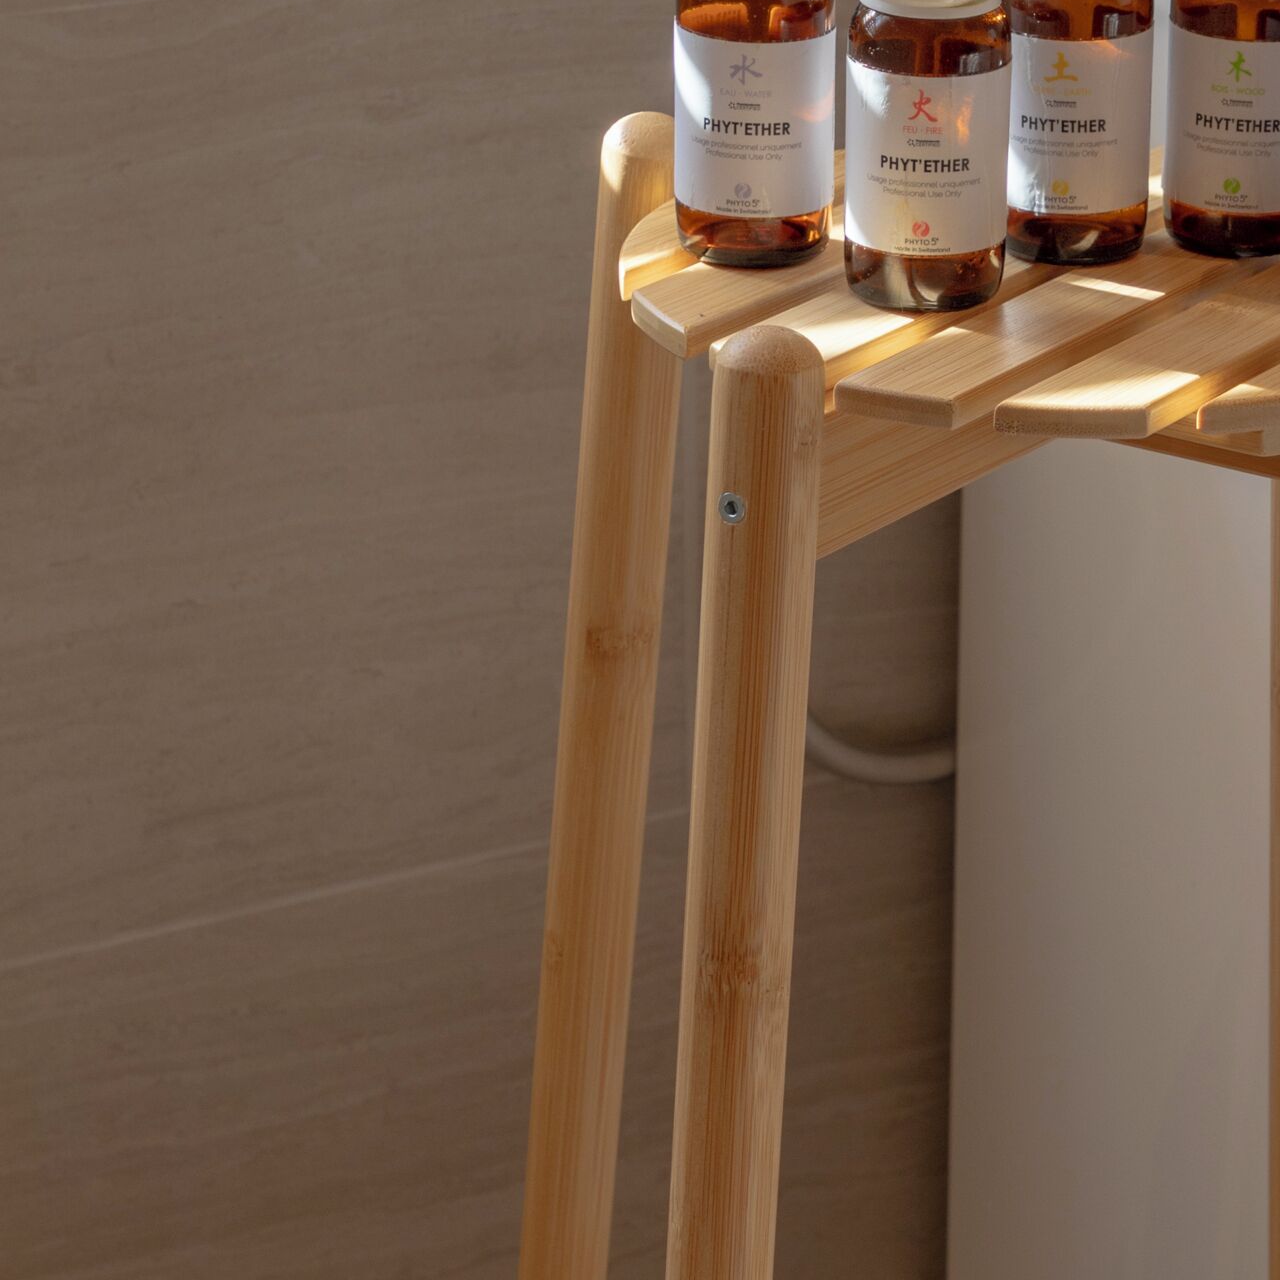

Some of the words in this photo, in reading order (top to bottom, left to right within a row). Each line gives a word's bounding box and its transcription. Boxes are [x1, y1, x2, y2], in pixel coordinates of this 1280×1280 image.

[729, 53, 763, 86] 水
[1044, 51, 1078, 82] 土
[1226, 51, 1252, 82] 木
[744, 89, 772, 98] WATER
[908, 88, 938, 122] 火
[703, 117, 791, 136] PHYT'ETHER
[1021, 114, 1106, 133] PHYT'ETHER
[1195, 112, 1280, 133] PHYT'ETHER
[903, 126, 917, 134] FEU
[926, 126, 944, 135] FIRE
[710, 140, 758, 150] professionnel
[760, 142, 802, 152] uniquement
[705, 148, 747, 160] Professional
[749, 152, 763, 160] Use
[765, 152, 783, 161] Only
[1082, 149, 1099, 157] Only
[1255, 149, 1271, 157] Only
[880, 155, 970, 173] PHYT'ETHER
[888, 176, 937, 188] professionnel
[939, 177, 981, 189] uniquement
[928, 190, 944, 198] Use
[945, 190, 962, 199] Only
[726, 199, 750, 207] PHYTO
[904, 238, 930, 246] PHYTO
